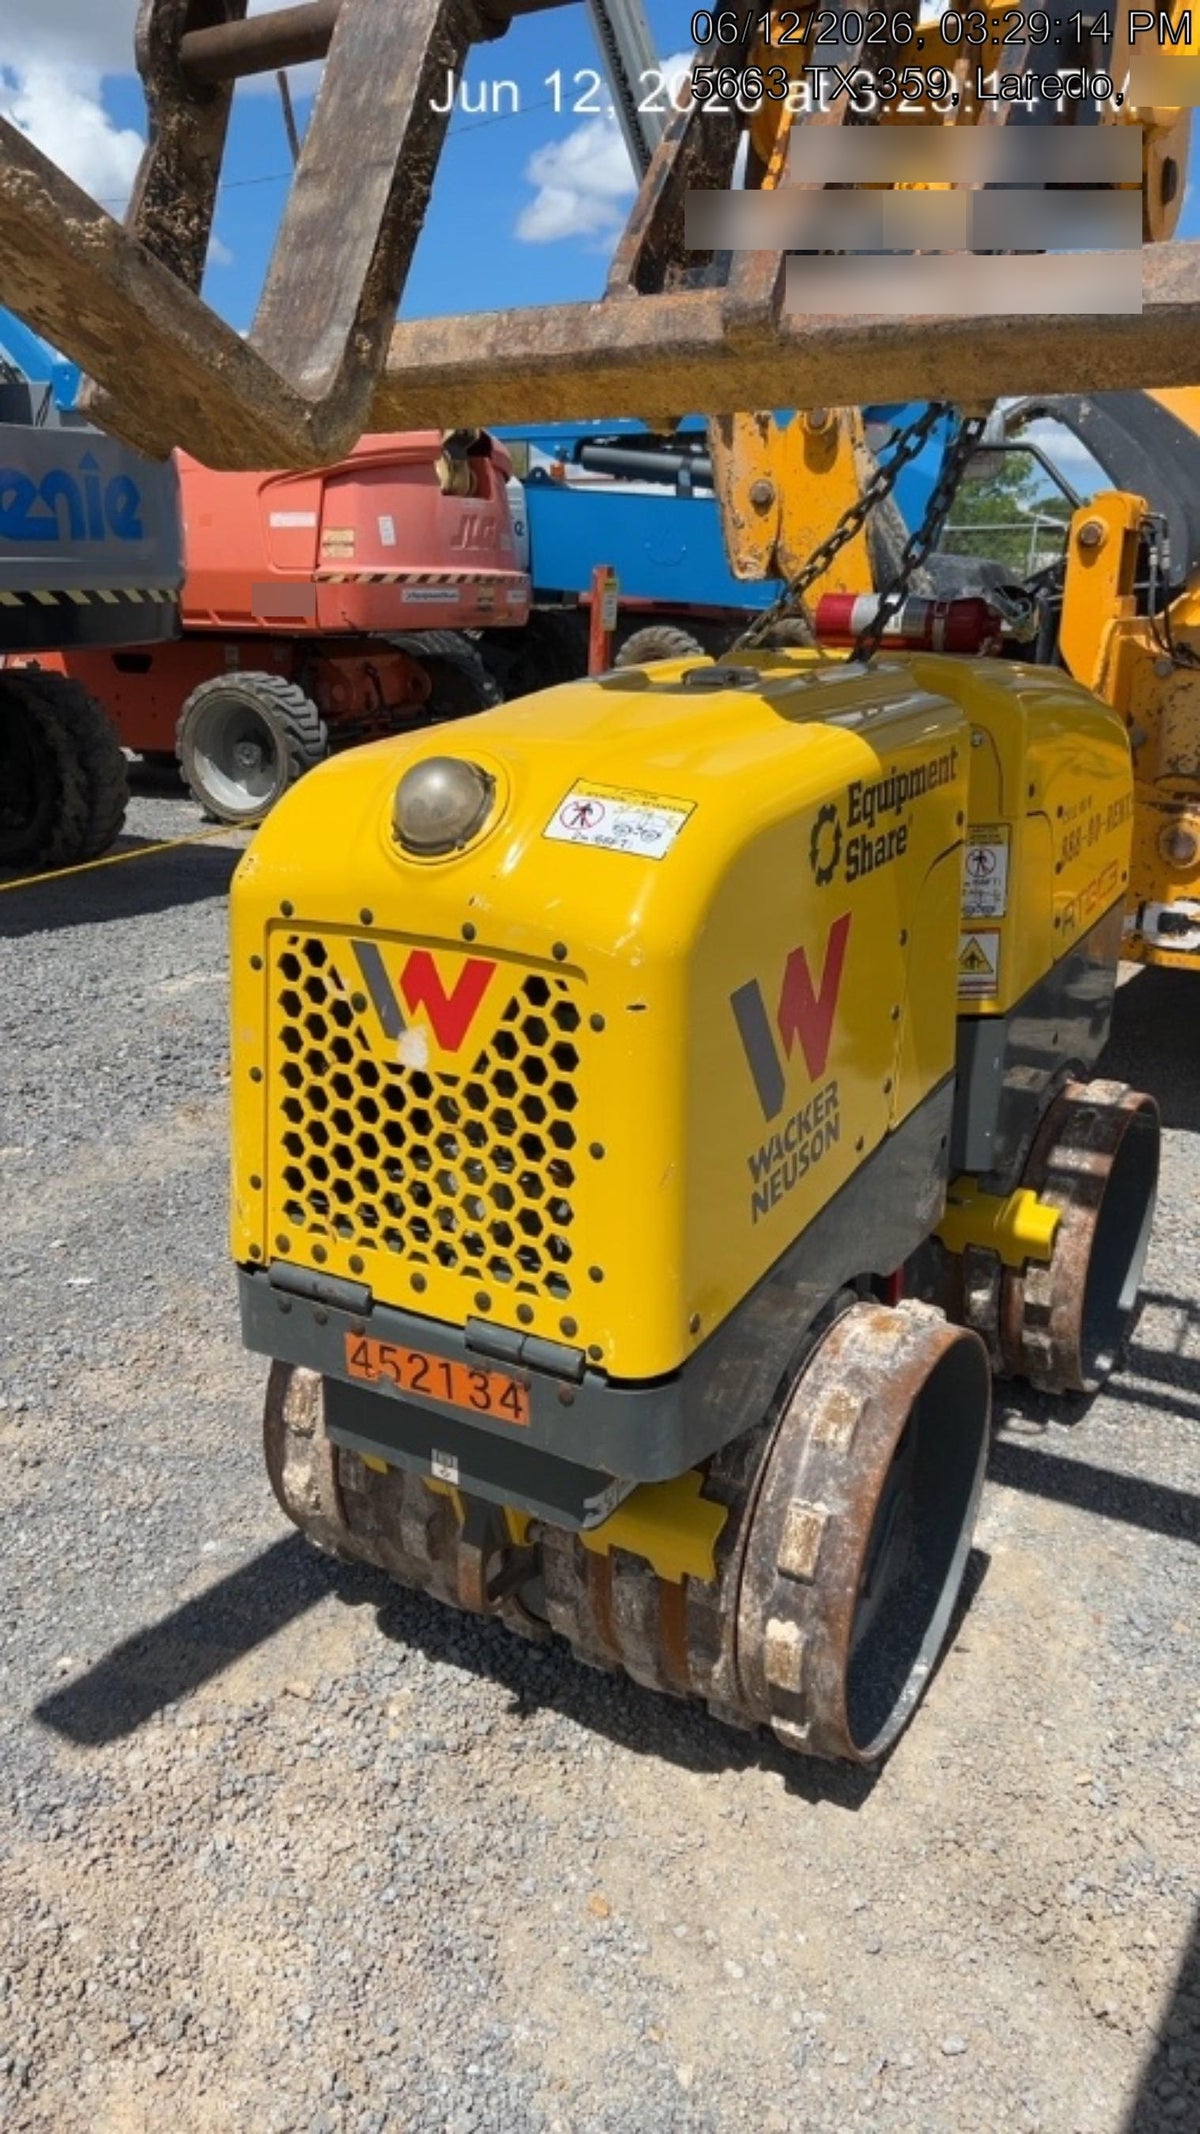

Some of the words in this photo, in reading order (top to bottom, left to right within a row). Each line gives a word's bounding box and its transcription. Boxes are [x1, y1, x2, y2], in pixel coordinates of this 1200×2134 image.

[847, 746, 958, 829] Equipment
[845, 824, 908, 883] Share
[747, 1080, 838, 1184] WACKER
[751, 1112, 839, 1225] NEUSON
[350, 1340, 523, 1418] 452134
